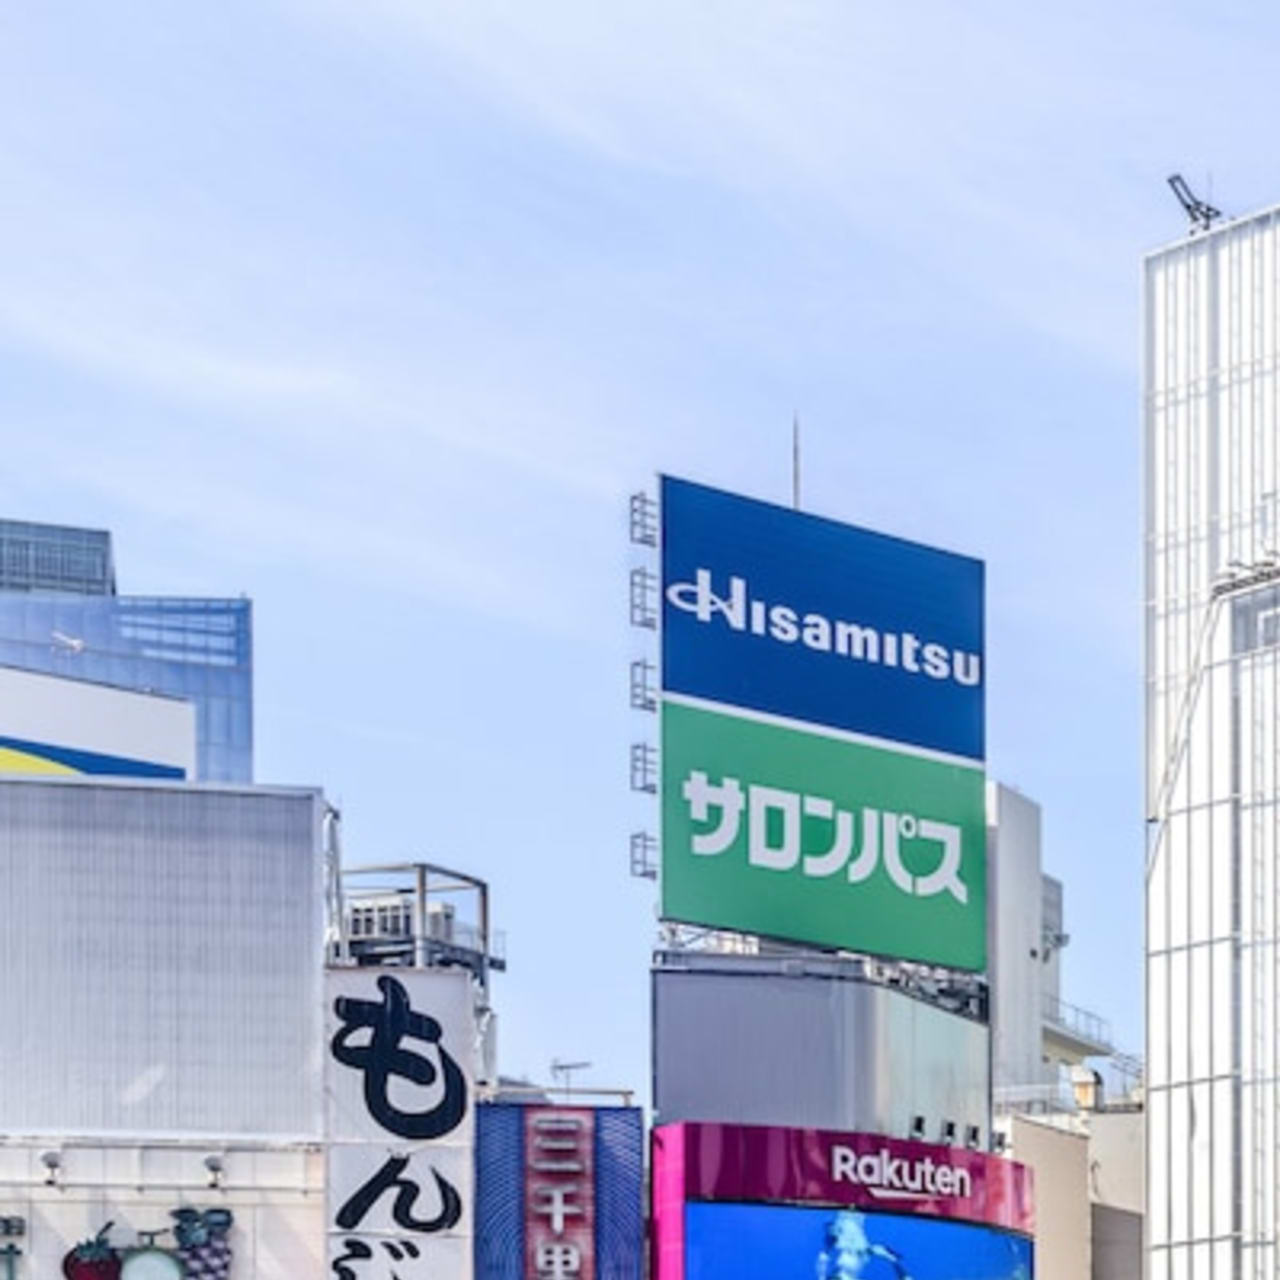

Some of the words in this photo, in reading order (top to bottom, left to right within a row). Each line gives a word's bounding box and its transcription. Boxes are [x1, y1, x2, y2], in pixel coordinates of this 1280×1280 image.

[666, 568, 981, 686] Hisamitsu
[683, 771, 968, 904] サロンパス
[832, 1145, 971, 1198] Rakuten
